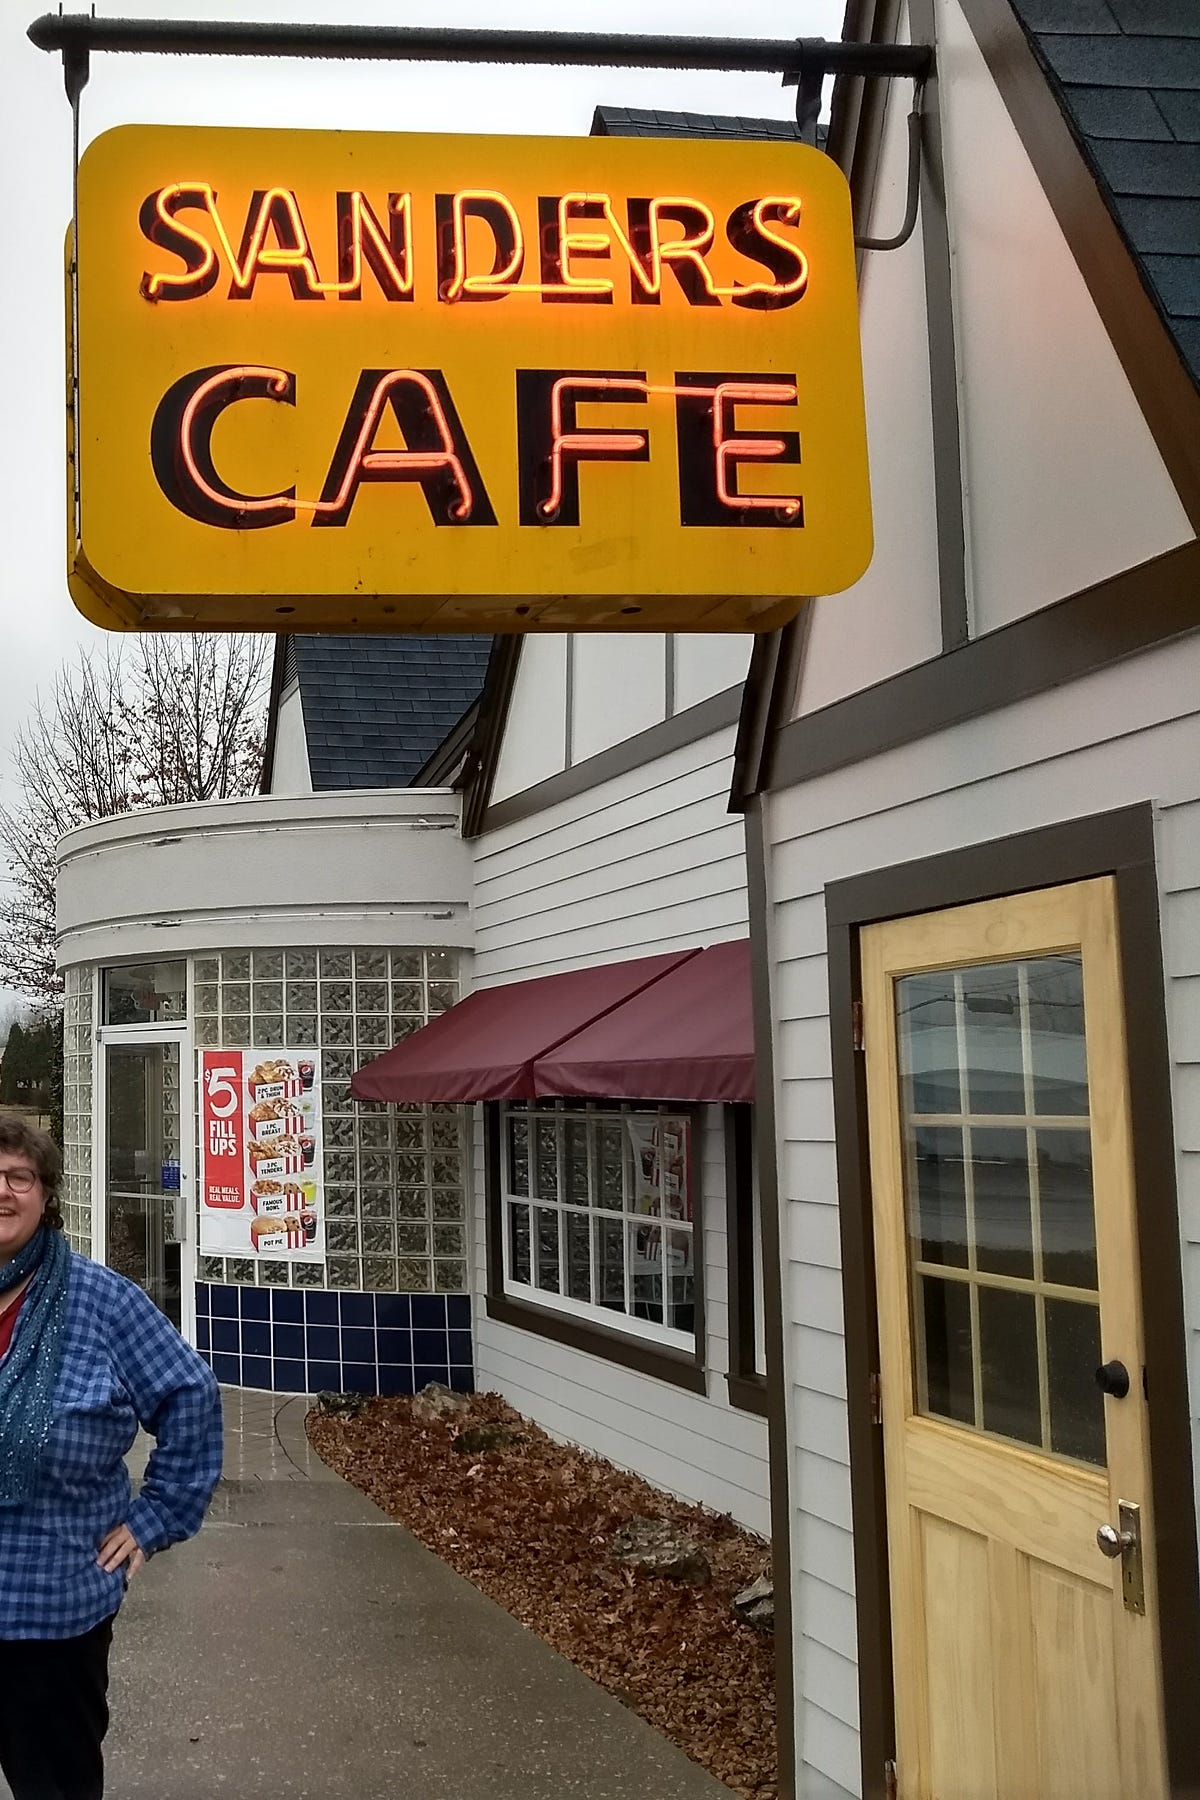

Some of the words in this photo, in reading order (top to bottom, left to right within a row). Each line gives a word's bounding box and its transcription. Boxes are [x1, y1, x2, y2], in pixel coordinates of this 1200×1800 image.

[139, 181, 809, 310] SANDERS
[151, 364, 805, 529] CAFE
[205, 1067, 238, 1118] $5
[209, 1120, 237, 1138] FILL
[261, 1128, 281, 1136] BREAST
[209, 1138, 238, 1156] UPS
[261, 1166, 283, 1175] TENDERS
[262, 1199, 283, 1207] FAMOUS
